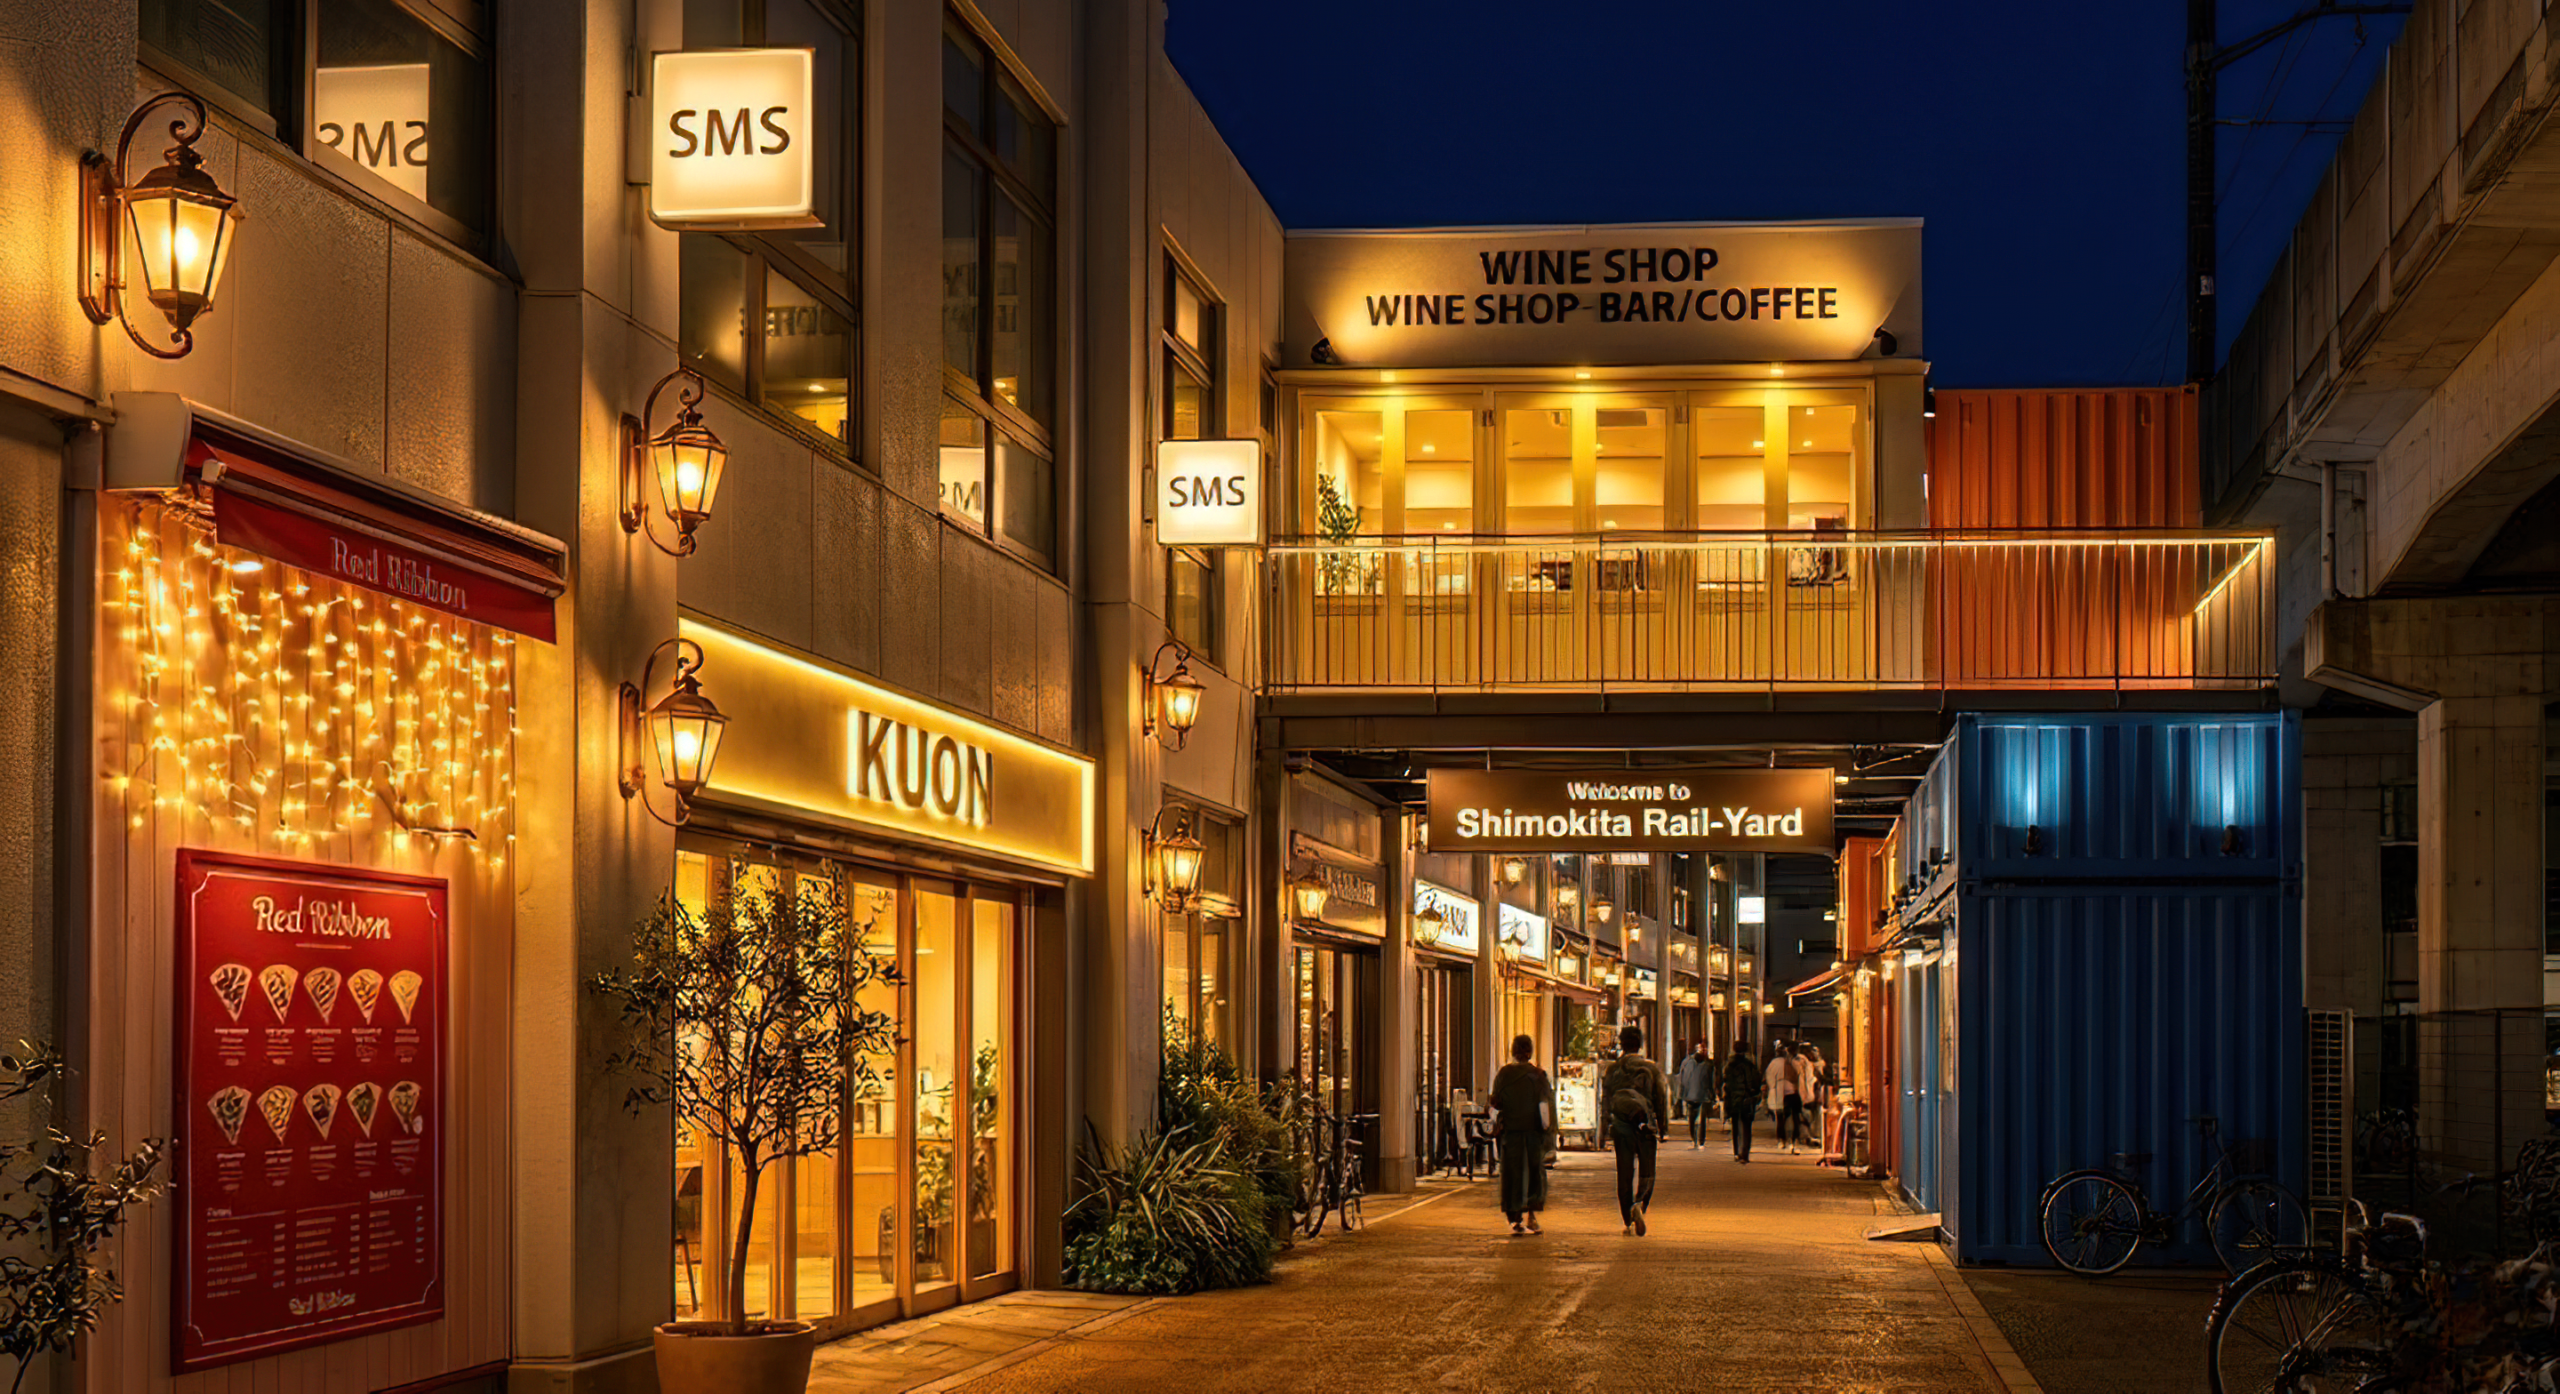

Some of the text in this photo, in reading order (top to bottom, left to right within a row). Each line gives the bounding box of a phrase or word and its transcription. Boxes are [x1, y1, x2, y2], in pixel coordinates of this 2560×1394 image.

[669, 106, 790, 158] SMS
[1480, 248, 1718, 285] WINE SHOP
[1366, 295, 1466, 326] WINE
[1169, 476, 1245, 507] SMS
[329, 537, 380, 585] Red
[857, 710, 993, 826] KUON
[1457, 807, 1803, 837] Shimokita Rail-Yard
[252, 895, 306, 932] Red
